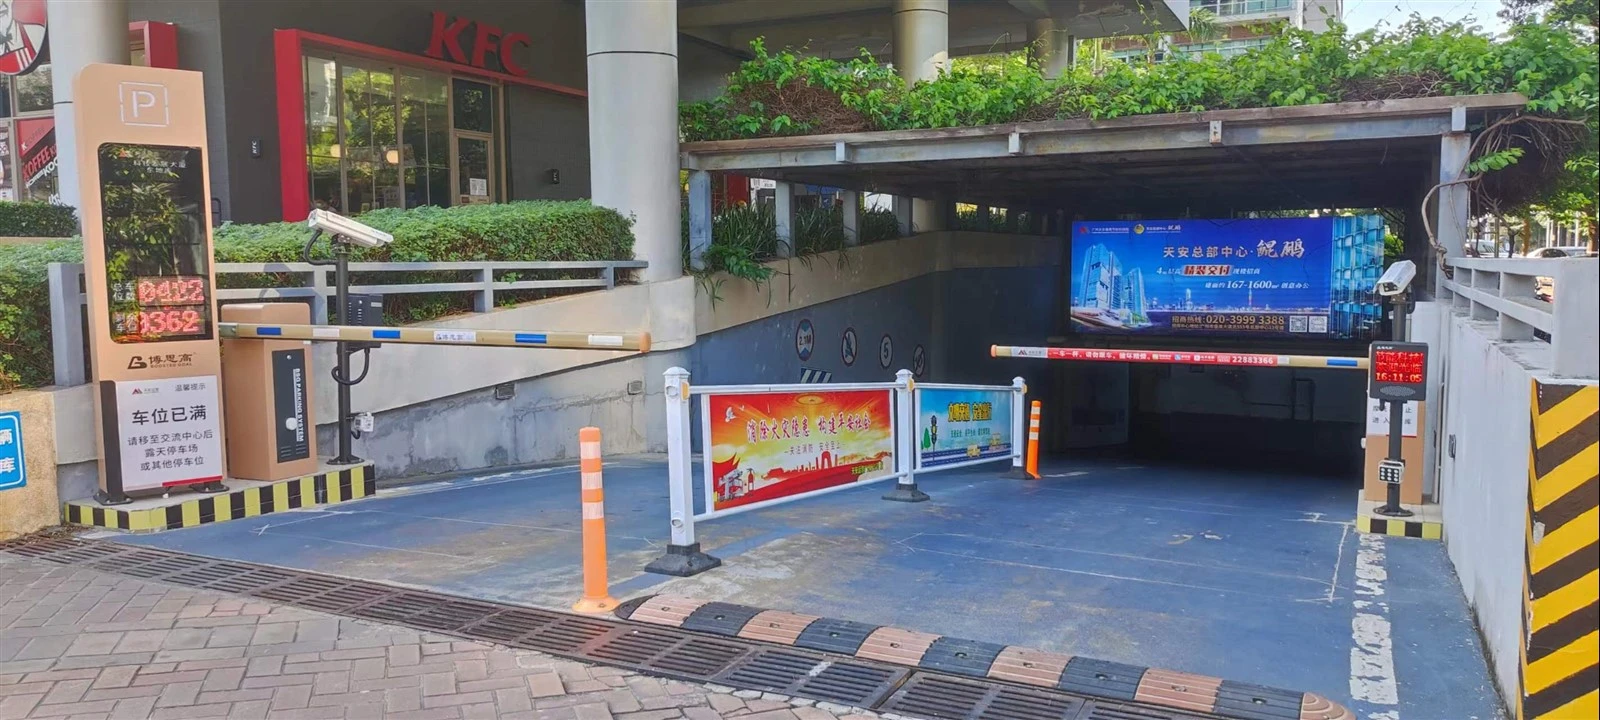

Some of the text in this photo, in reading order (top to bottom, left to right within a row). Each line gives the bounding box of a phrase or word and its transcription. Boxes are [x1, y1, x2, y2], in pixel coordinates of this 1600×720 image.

[425, 10, 532, 76] KFC
[132, 91, 156, 118] P
[1183, 265, 1231, 275] 精装交付
[883, 343, 889, 359] 5
[149, 354, 193, 364] 博思高
[1232, 355, 1273, 365] 22883366
[1376, 362, 1423, 373] 欢迎光临
[1376, 372, 1423, 382] 16:11:05
[175, 383, 207, 392] 温馨提示
[132, 405, 207, 426] 车位已满
[746, 411, 872, 443] 消除火灾隐患 构建平安社会
[128, 429, 213, 446] 请移至交流中心后
[145, 445, 199, 458] 露天停车场
[0, 457, 16, 475] 库
[140, 457, 205, 471] 或其他停车位
